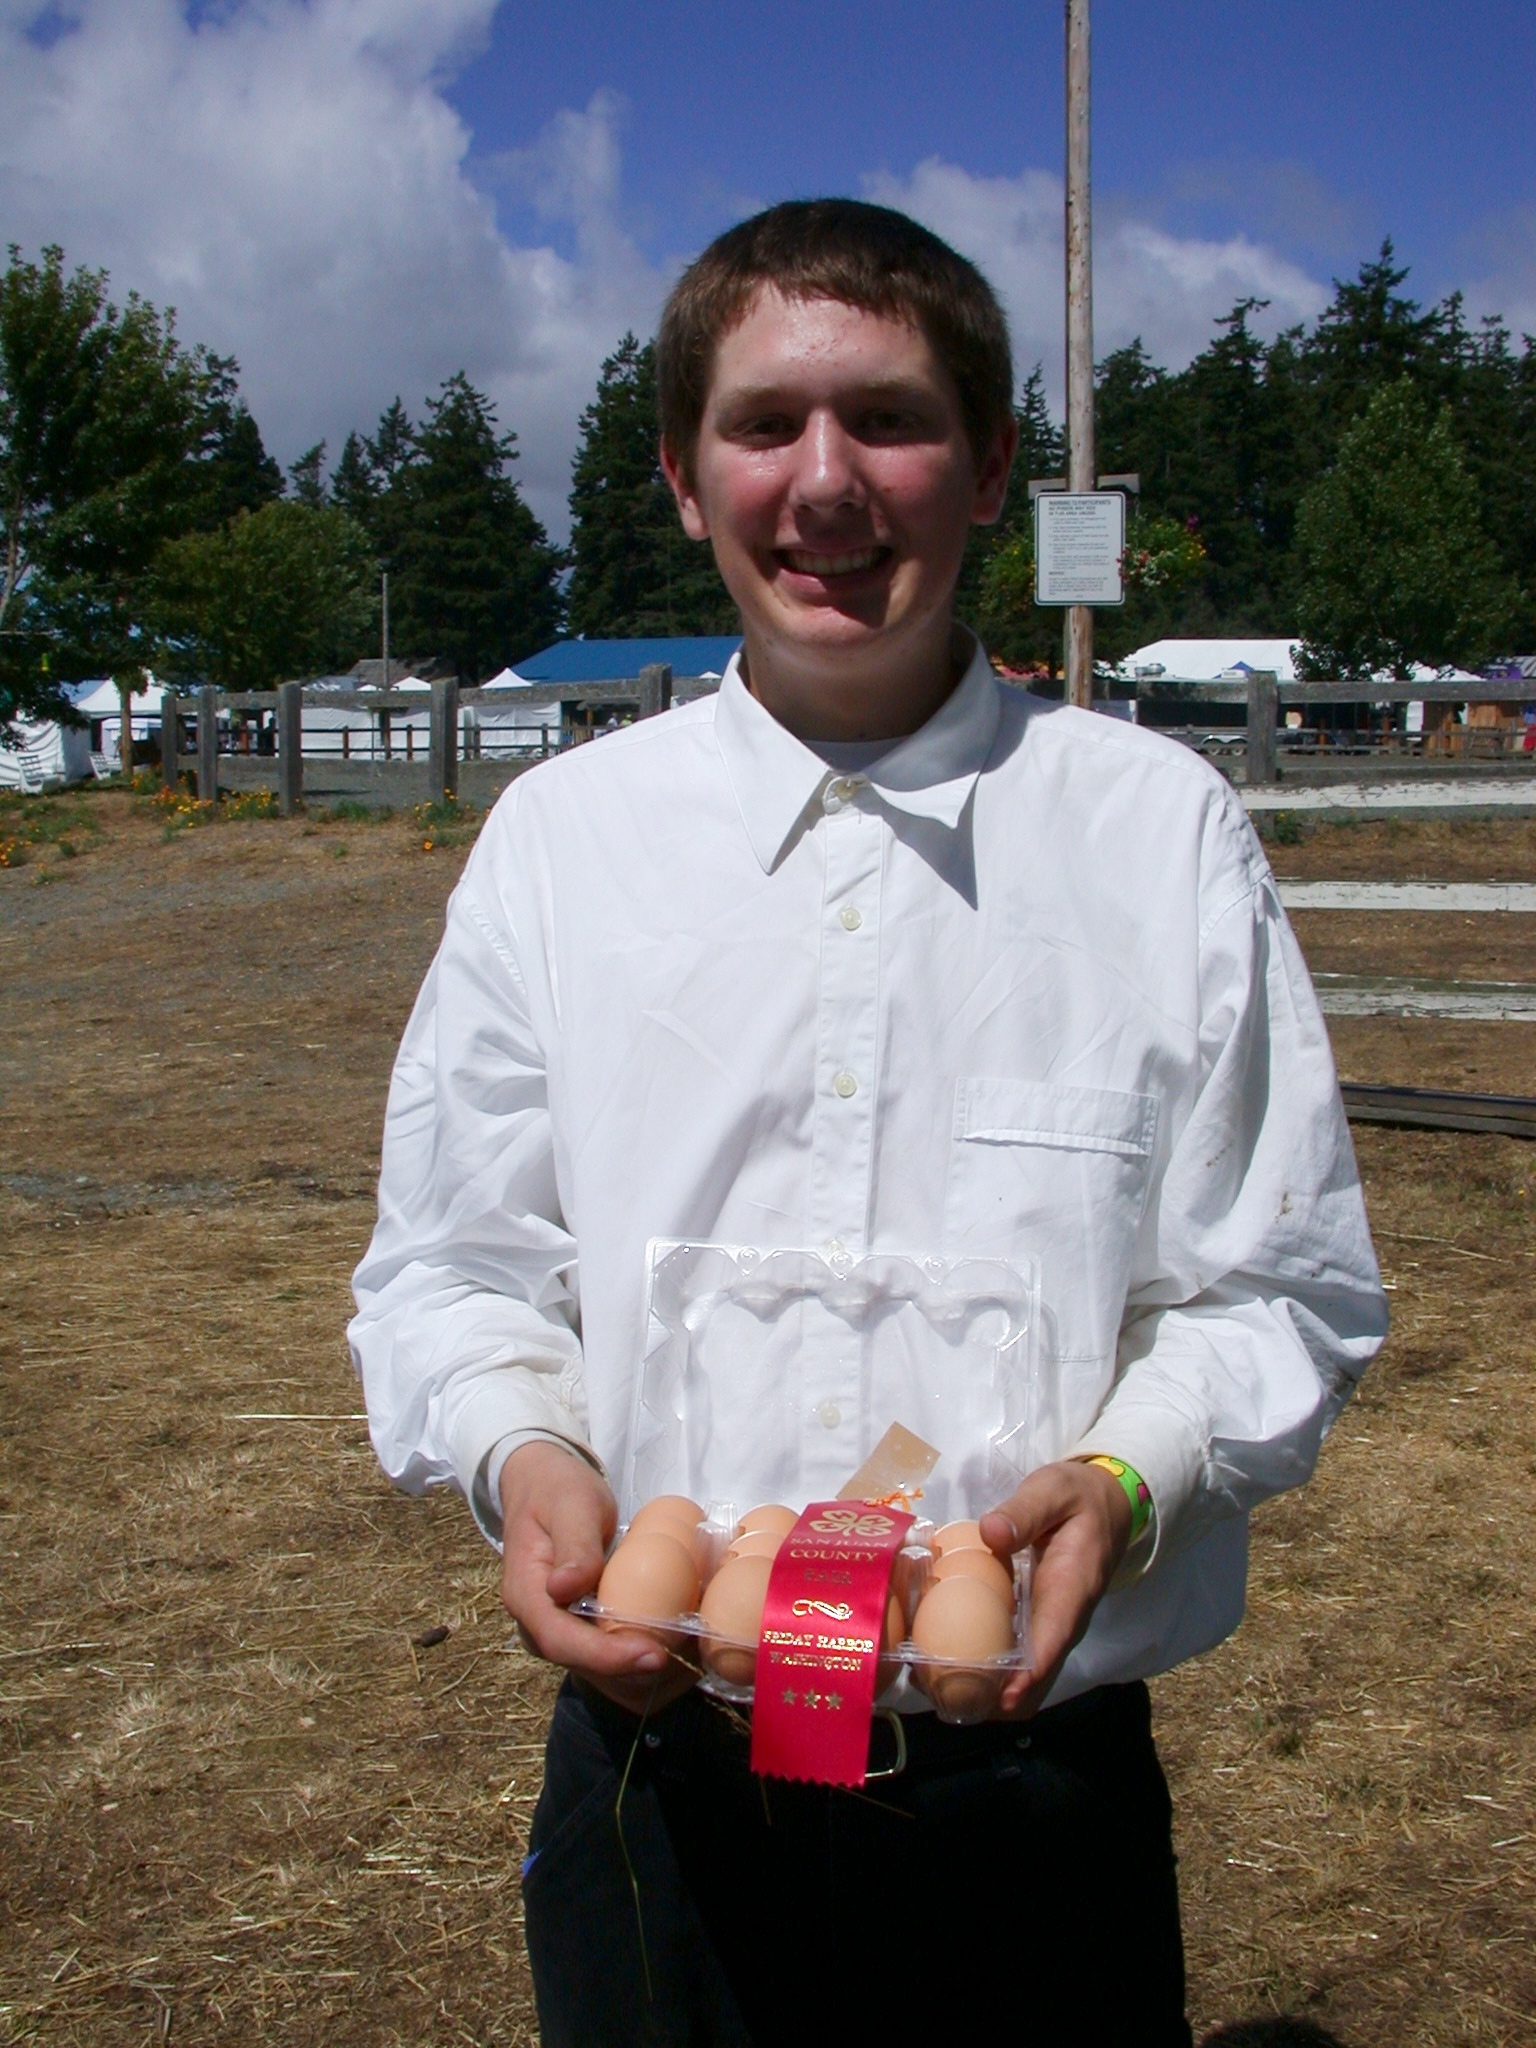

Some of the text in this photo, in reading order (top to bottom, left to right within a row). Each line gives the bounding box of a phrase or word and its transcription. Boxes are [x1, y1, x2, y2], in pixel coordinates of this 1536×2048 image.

[790, 1537, 890, 1548] SAN JUAN
[789, 1548, 880, 1562] COUNTY
[804, 1567, 853, 1585] FAIR
[762, 1630, 875, 1653] FRIDAY HARBOR
[769, 1650, 863, 1671] WASHINGTON
